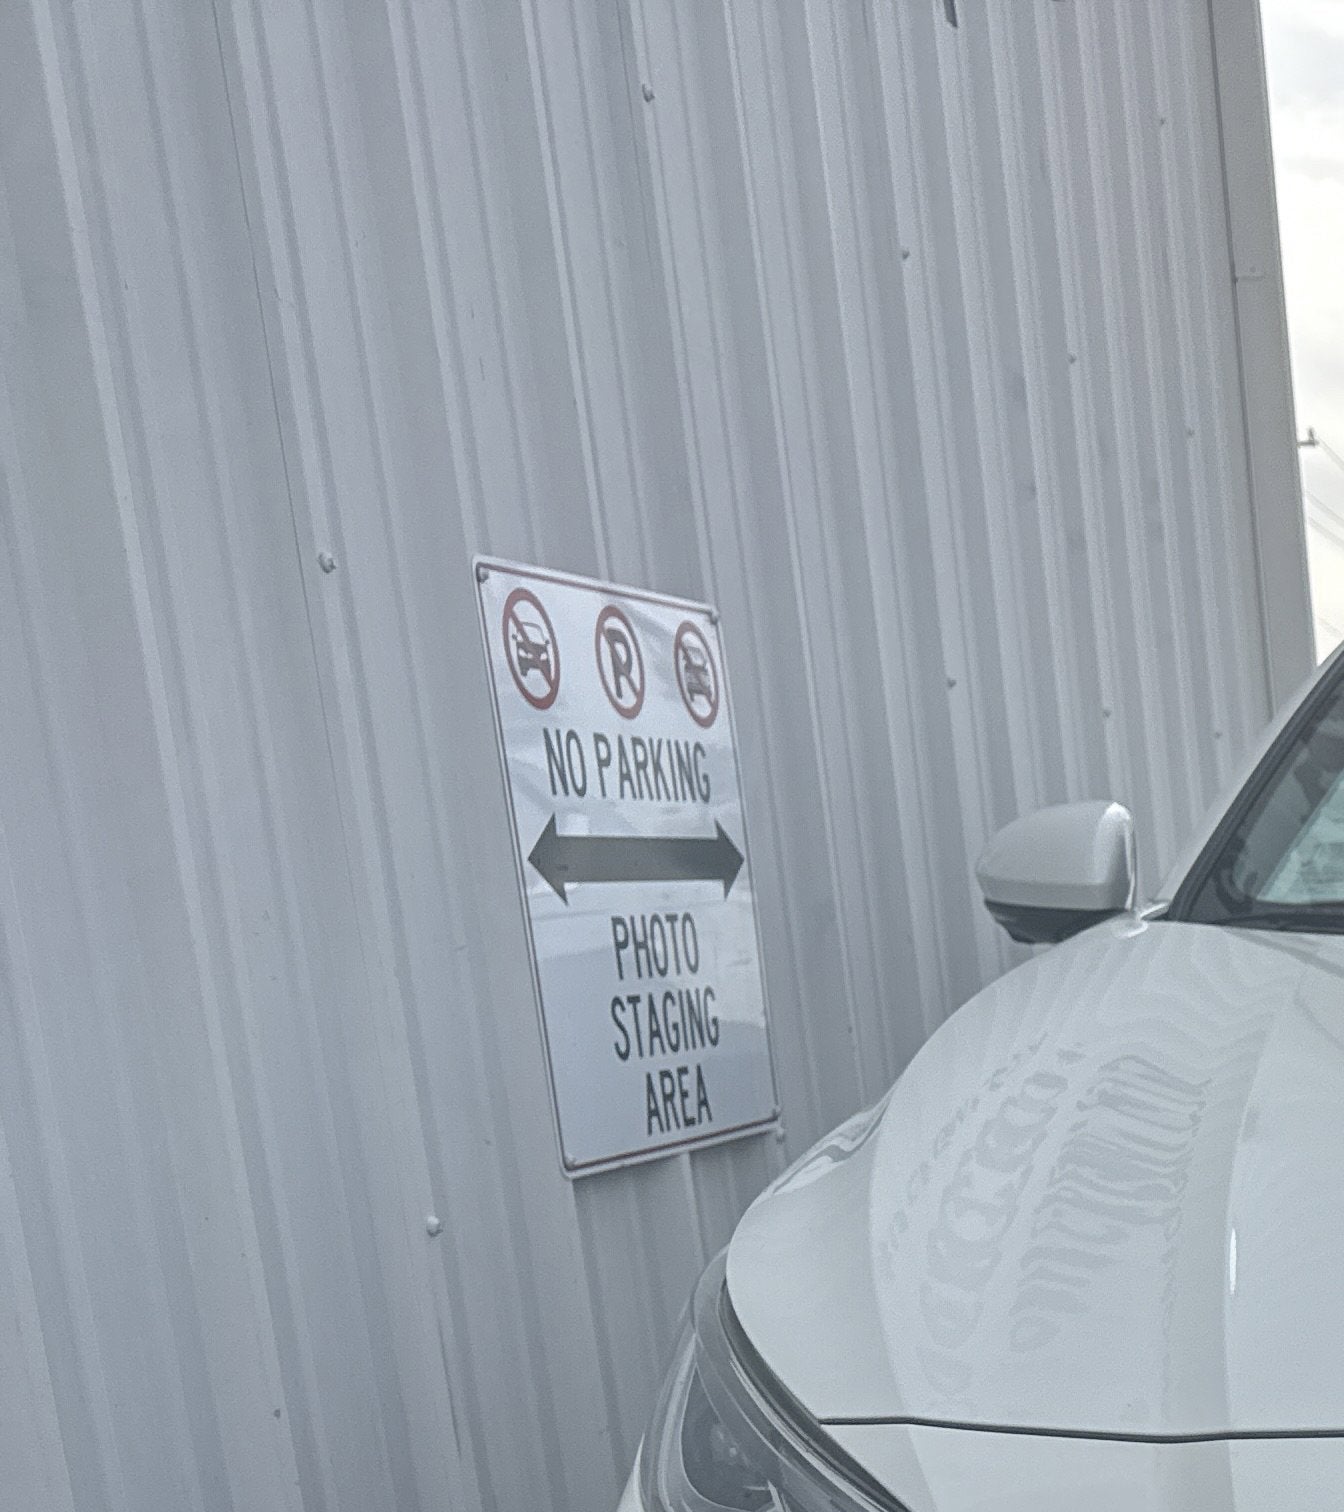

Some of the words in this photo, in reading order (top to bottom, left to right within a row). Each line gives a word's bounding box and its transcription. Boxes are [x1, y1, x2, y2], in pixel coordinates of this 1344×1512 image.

[543, 727, 587, 798] NO
[593, 732, 711, 803] PARKING
[611, 912, 699, 980] PHOTO
[610, 985, 719, 1061] STAGING
[646, 1063, 713, 1136] AREA
